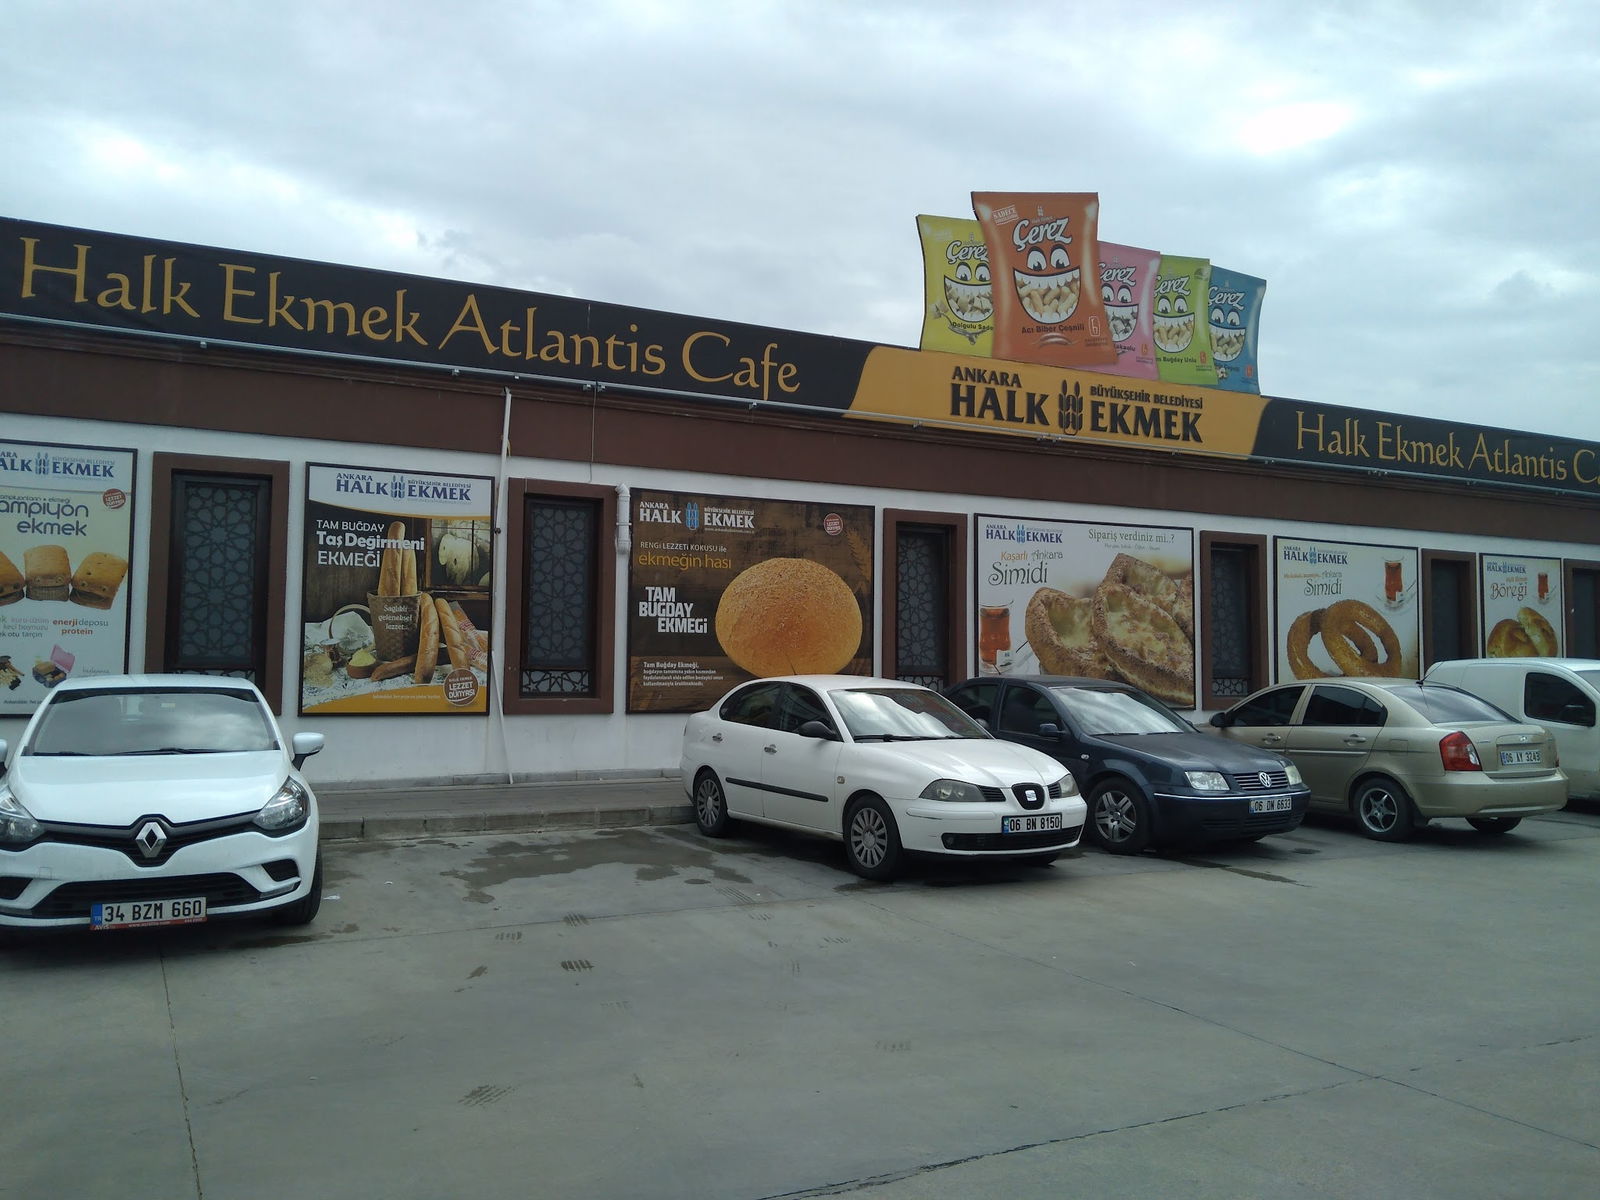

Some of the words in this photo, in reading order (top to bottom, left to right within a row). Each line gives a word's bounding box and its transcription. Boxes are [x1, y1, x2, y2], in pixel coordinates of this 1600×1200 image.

[1013, 217, 1072, 251] Çerez
[19, 236, 200, 318] Halk
[219, 263, 429, 346] Ekmek
[438, 294, 666, 375] Atlantis
[682, 331, 800, 400] Cafe
[952, 366, 1022, 388] ANKARA
[950, 383, 1051, 426] HALK
[1090, 384, 1151, 403] BÜYÜKŞEHİR
[1153, 393, 1203, 409] BELEDİYESİ
[1089, 401, 1203, 443] EKMEK
[1296, 411, 1370, 458] Halk
[1376, 421, 1464, 469] Ekmek
[1468, 433, 1567, 480] Atlantis
[1573, 449, 1600, 484] C
[52, 461, 114, 478] EKMEK
[336, 472, 373, 481] ANKARA
[336, 478, 389, 496] HALK
[407, 485, 472, 501] EKMEK
[639, 501, 669, 509] ANKARA
[639, 508, 682, 524] HALK
[704, 512, 755, 529] EKMEK
[17, 518, 88, 536] ekmek
[316, 519, 339, 530] TAM
[341, 520, 385, 532] BUĞDAY
[316, 531, 343, 549] Taş
[344, 532, 425, 550] Değirmeni
[986, 529, 1016, 541] HALK
[1026, 531, 1063, 544] EKMEK
[1088, 528, 1118, 542] Sipariş
[1119, 530, 1153, 542] verdiniz
[690, 544, 718, 552] KOKUSU
[1000, 550, 1028, 562] Kaşarlı
[1283, 550, 1309, 562] HALK
[317, 550, 380, 568] EKMEĞİ
[638, 552, 702, 571] ekmeğin
[705, 554, 732, 569] hası
[1317, 553, 1348, 565] EKMEK
[988, 559, 1048, 586] Simidi
[645, 586, 676, 602] TAM
[1304, 578, 1343, 596] Simidi
[1490, 582, 1528, 601] Böreği
[52, 618, 78, 628] enerji
[78, 618, 109, 628] deposu
[61, 627, 93, 636] protein
[449, 681, 473, 690] LEZZET
[1254, 801, 1263, 811] 06
[1010, 818, 1020, 832] 06
[1026, 817, 1037, 830] BN
[1040, 816, 1060, 829] 8150
[105, 906, 125, 922] 34
[132, 902, 163, 920] BZM
[172, 900, 201, 917] 660
